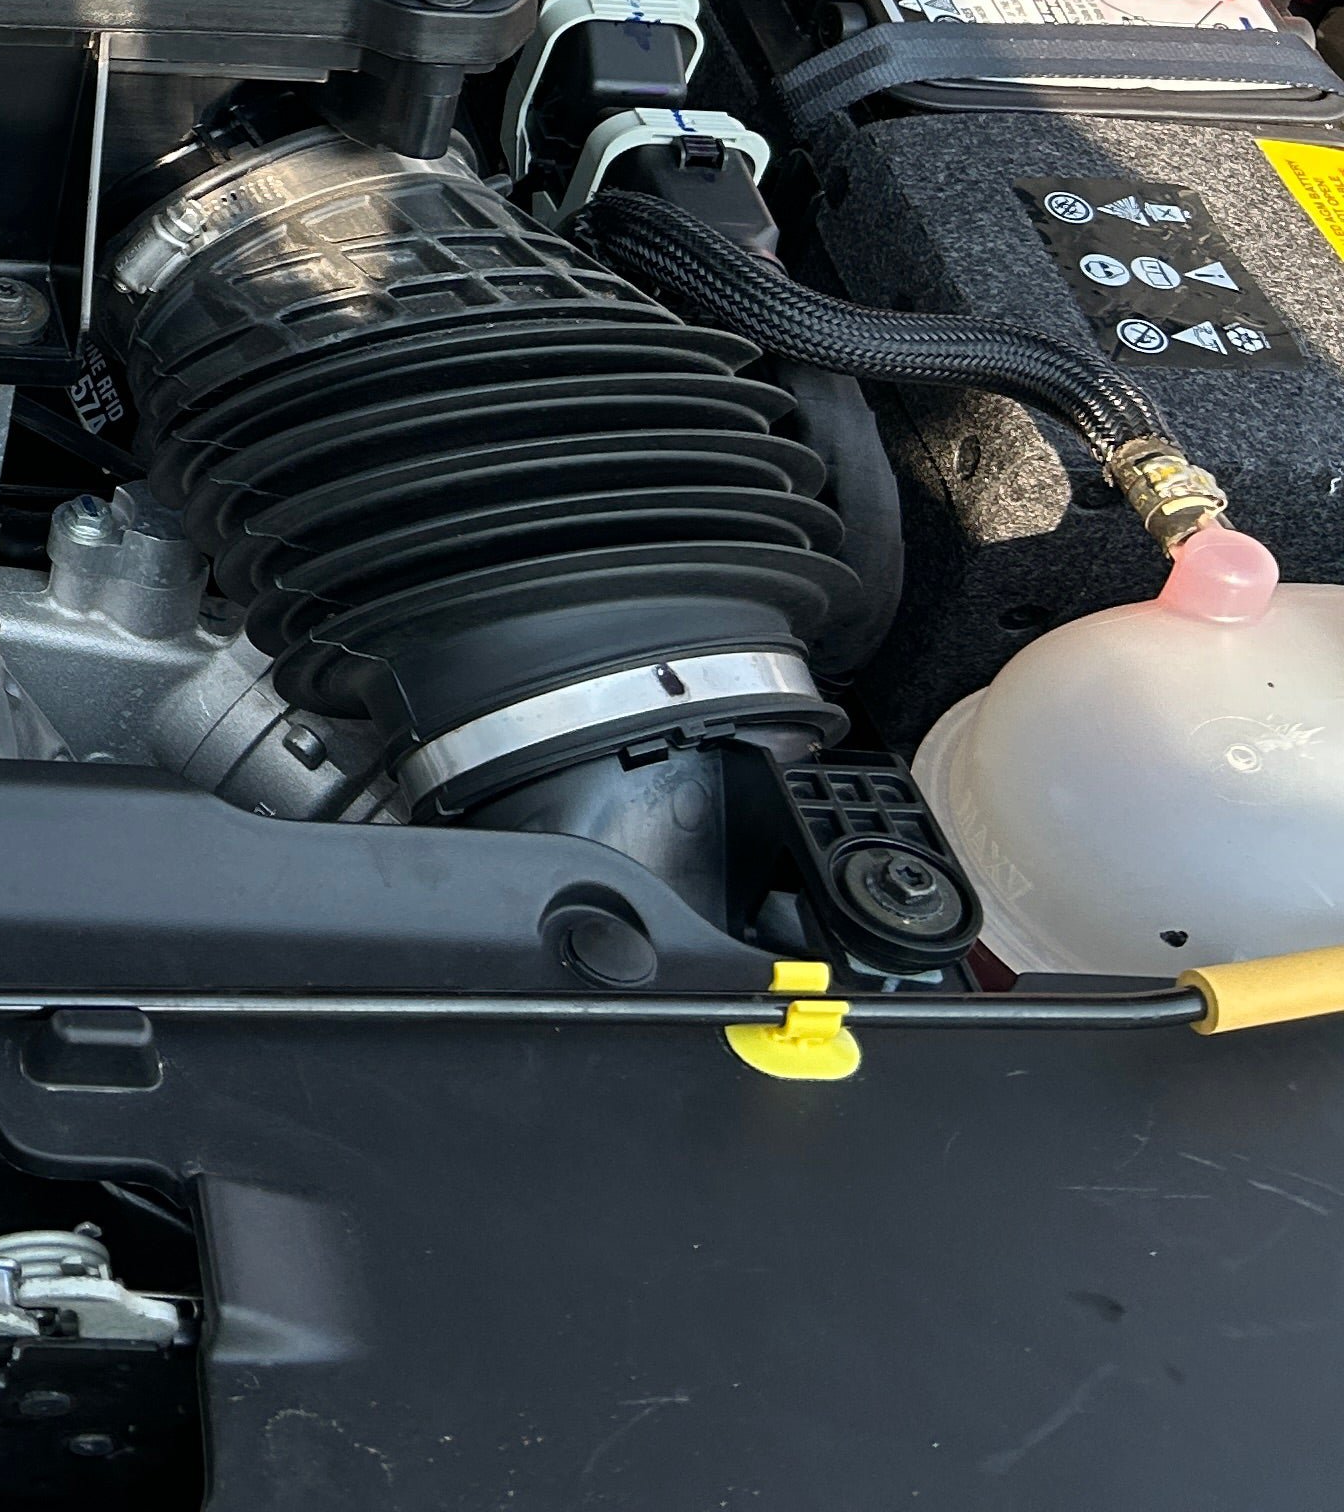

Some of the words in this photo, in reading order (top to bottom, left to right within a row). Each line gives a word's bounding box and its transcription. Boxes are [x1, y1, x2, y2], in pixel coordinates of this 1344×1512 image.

[1285, 159, 1320, 200] BATTERY
[1314, 202, 1336, 222] AGM
[97, 375, 124, 422] RFID
